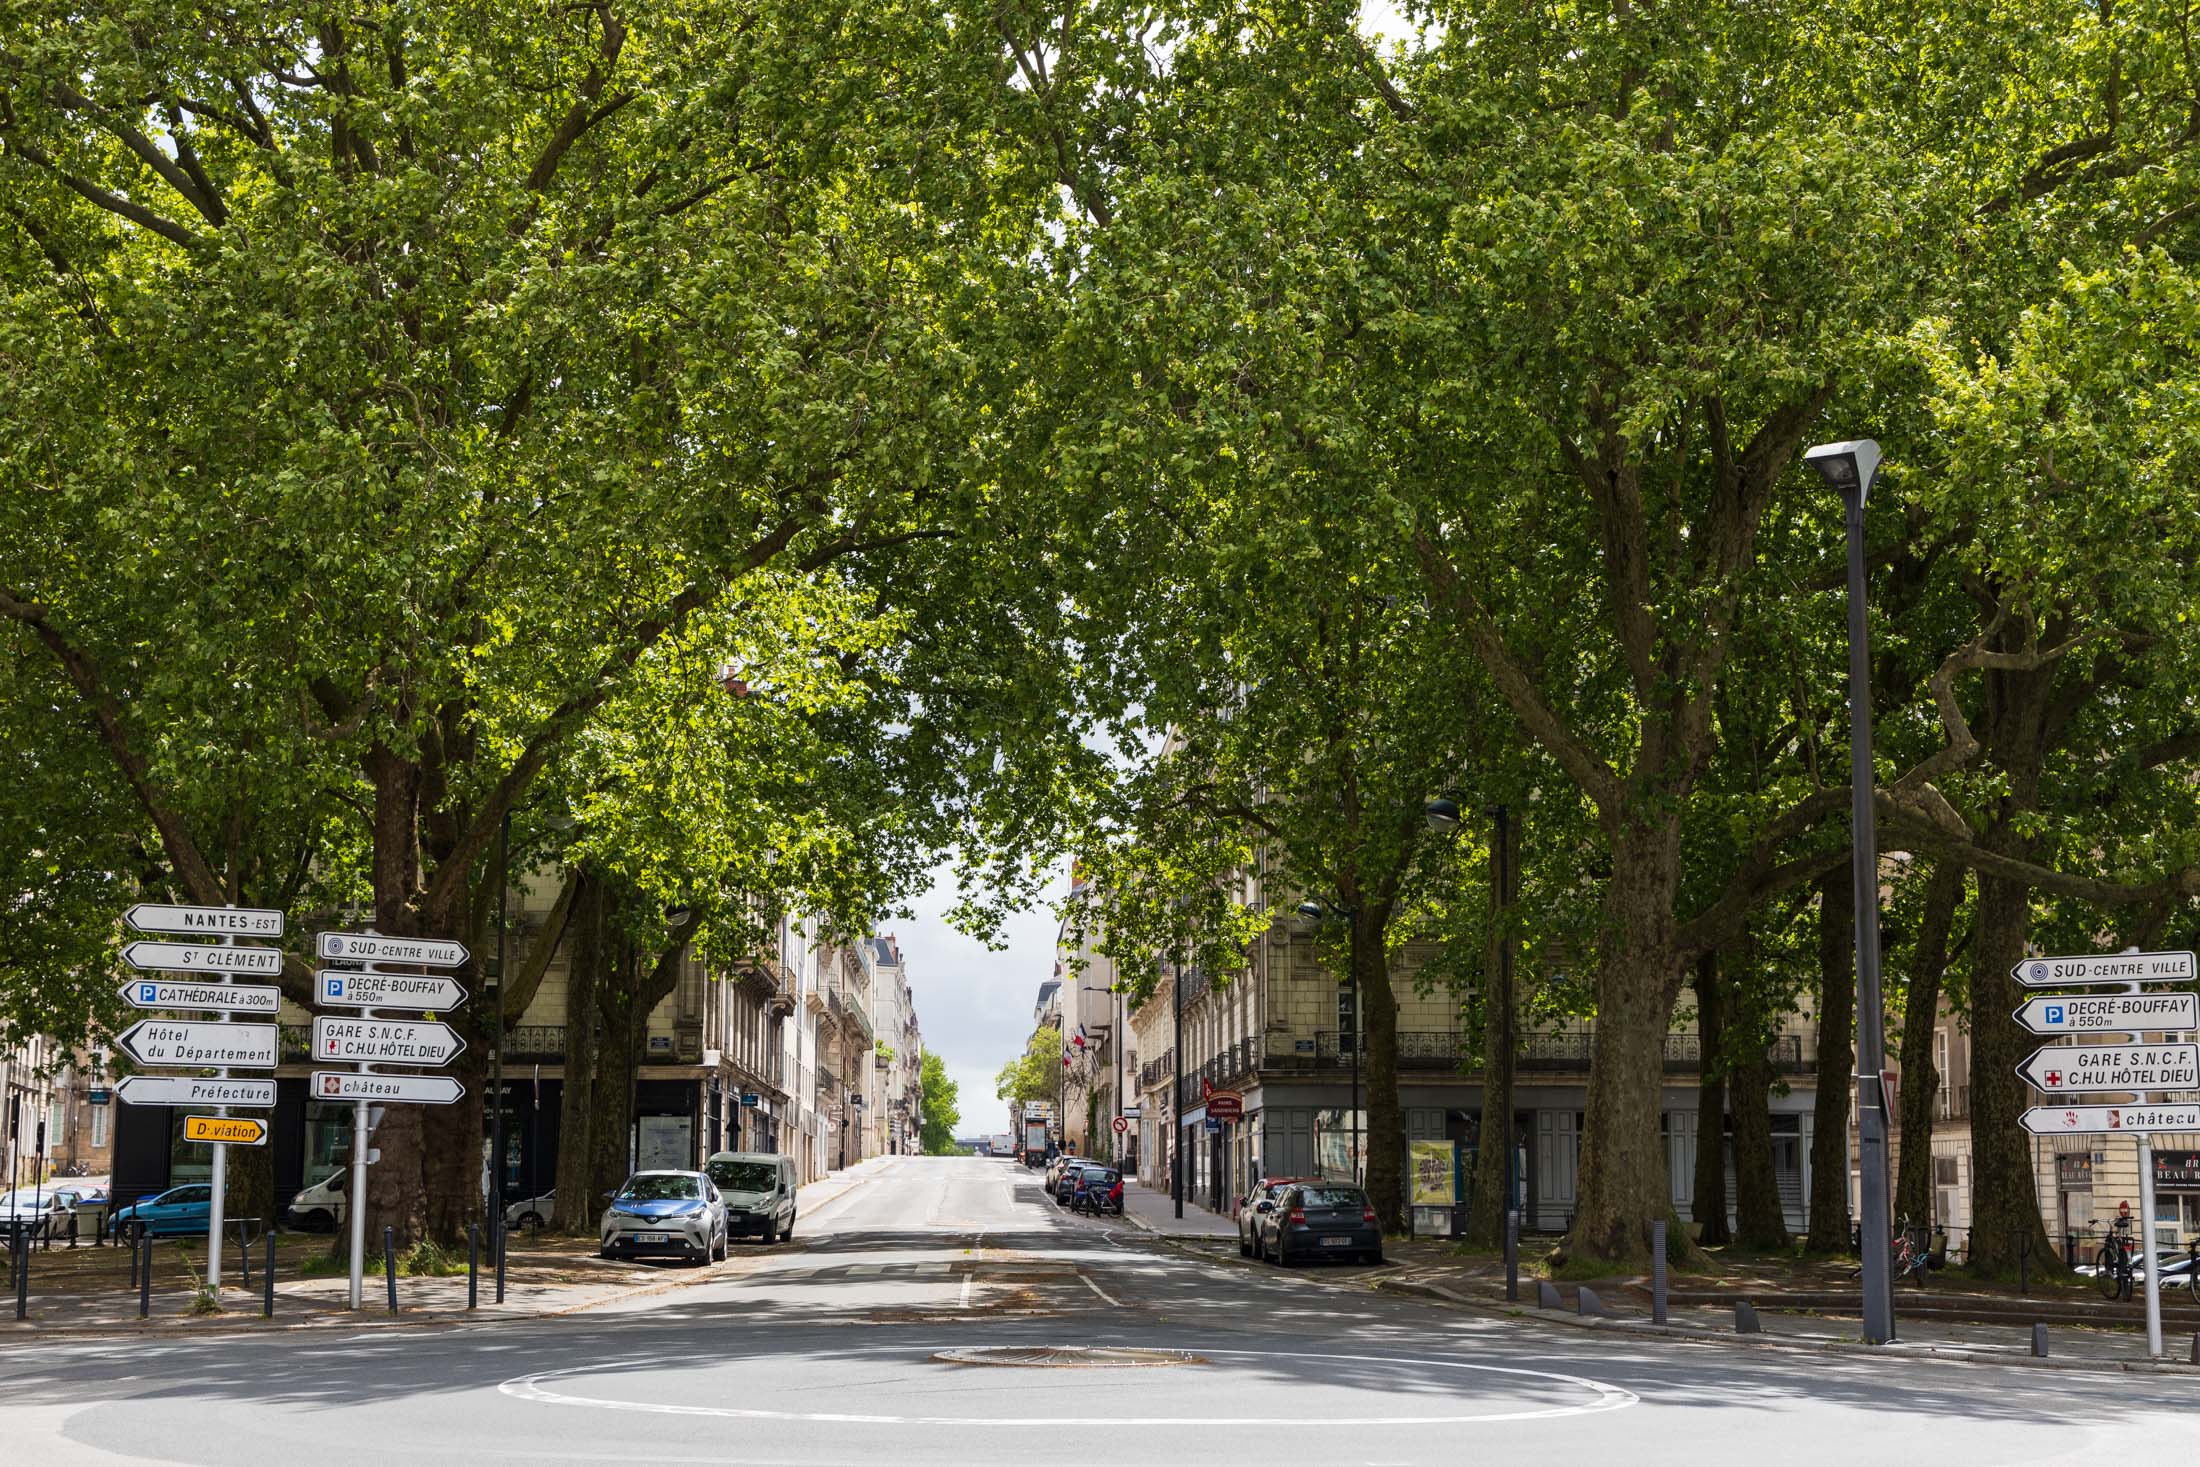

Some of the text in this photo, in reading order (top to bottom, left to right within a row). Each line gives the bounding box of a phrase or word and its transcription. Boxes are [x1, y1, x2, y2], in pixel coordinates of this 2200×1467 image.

[207, 951, 276, 967] CLÉMENT
[349, 941, 455, 961] SUD-CENTRE VILLE
[2054, 961, 2186, 978] SUD-CENTRE VILLE
[348, 976, 445, 994] DECRÉ-BOUFFAY
[159, 987, 238, 1004] CATHÉDRALE
[239, 994, 245, 1005] à
[246, 994, 273, 1006] 300m
[347, 991, 383, 1002] à 550m
[2068, 998, 2189, 1015] DECRÉ-BOUFFAY
[2069, 1016, 2113, 1027] à 550m
[148, 1027, 189, 1041] Hôtel
[326, 1024, 417, 1041] GARE S.N.C.F.
[148, 1045, 271, 1061] du Département
[345, 1041, 445, 1058] C.H.U. HÔTEL DIEU
[2078, 1051, 2191, 1067] GARE S.N.C.F.
[2069, 1067, 2194, 1085] C.H.U. HÔTEL DIEU
[191, 1085, 270, 1099] Préfecture
[197, 1123, 256, 1138] Dviation
[2157, 1170, 2188, 1180] BEAU
